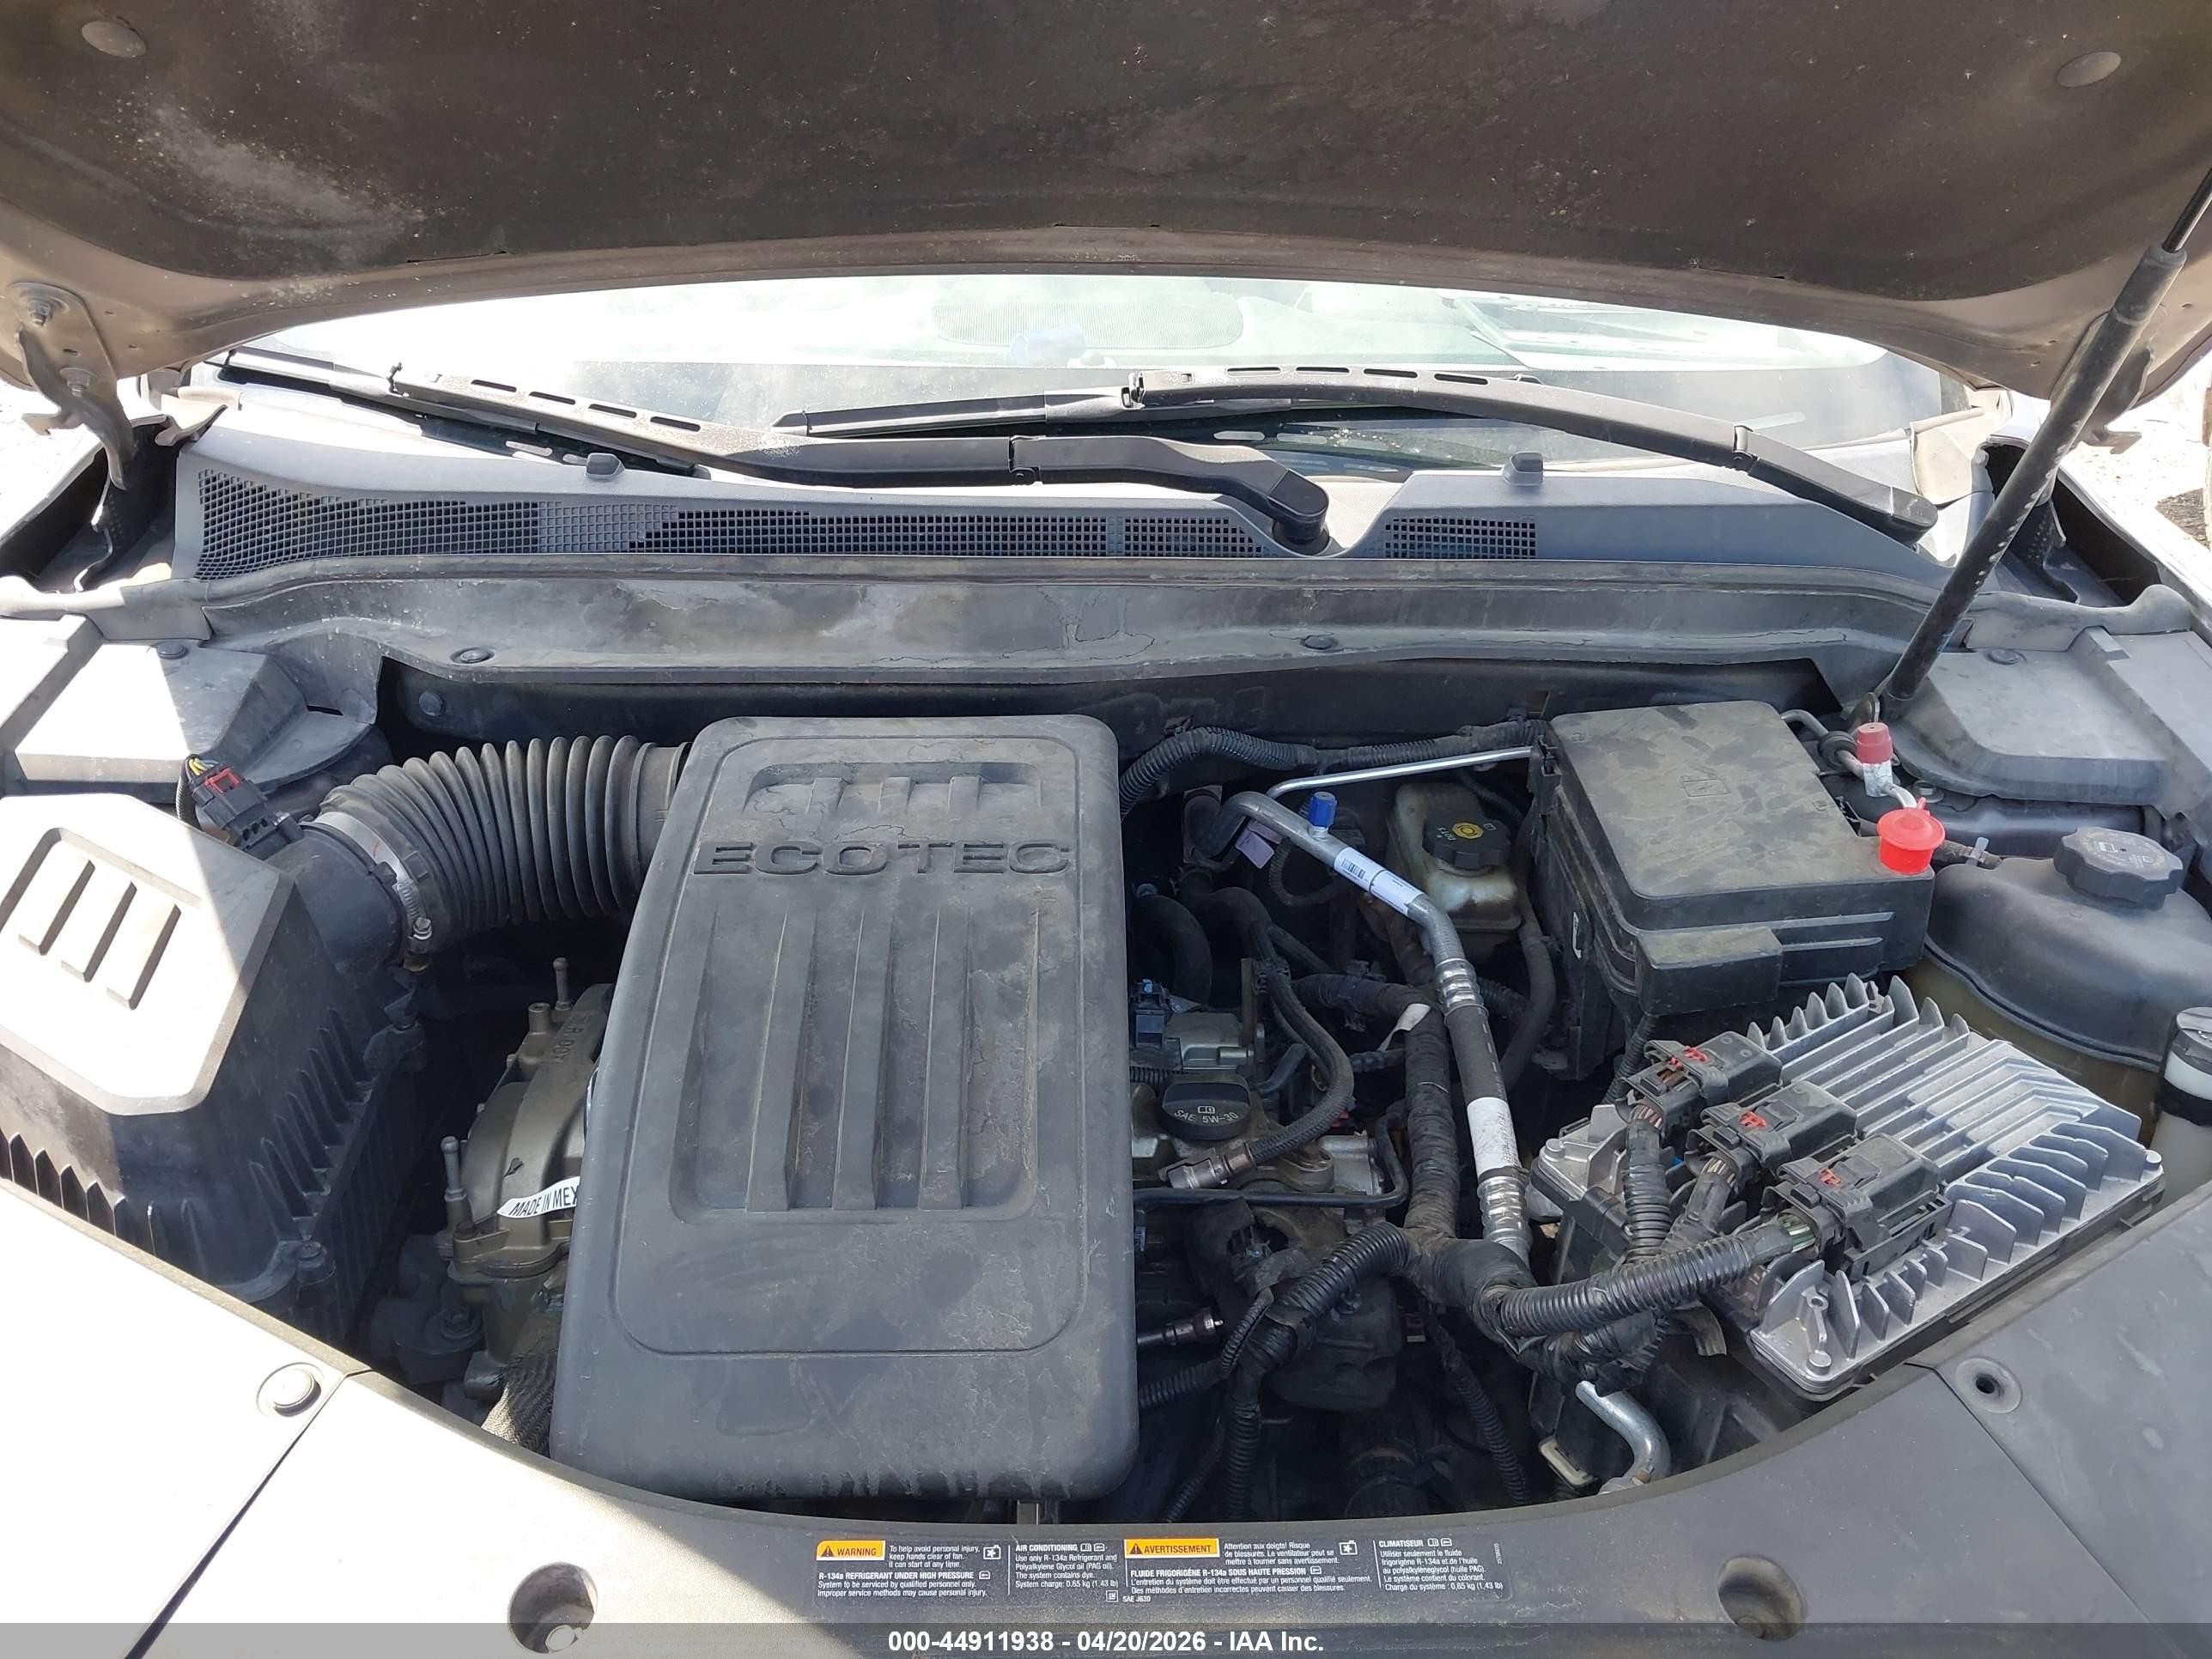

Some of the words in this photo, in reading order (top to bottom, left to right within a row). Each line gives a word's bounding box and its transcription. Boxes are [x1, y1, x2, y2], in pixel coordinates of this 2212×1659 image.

[693, 841, 1071, 874] ECOTEC
[1175, 1110, 1195, 1121] SAE
[1202, 1112, 1238, 1123] 5W-30
[508, 1197, 541, 1216] MADE
[542, 1192, 551, 1212] IN
[837, 1547, 877, 1556] WARNING
